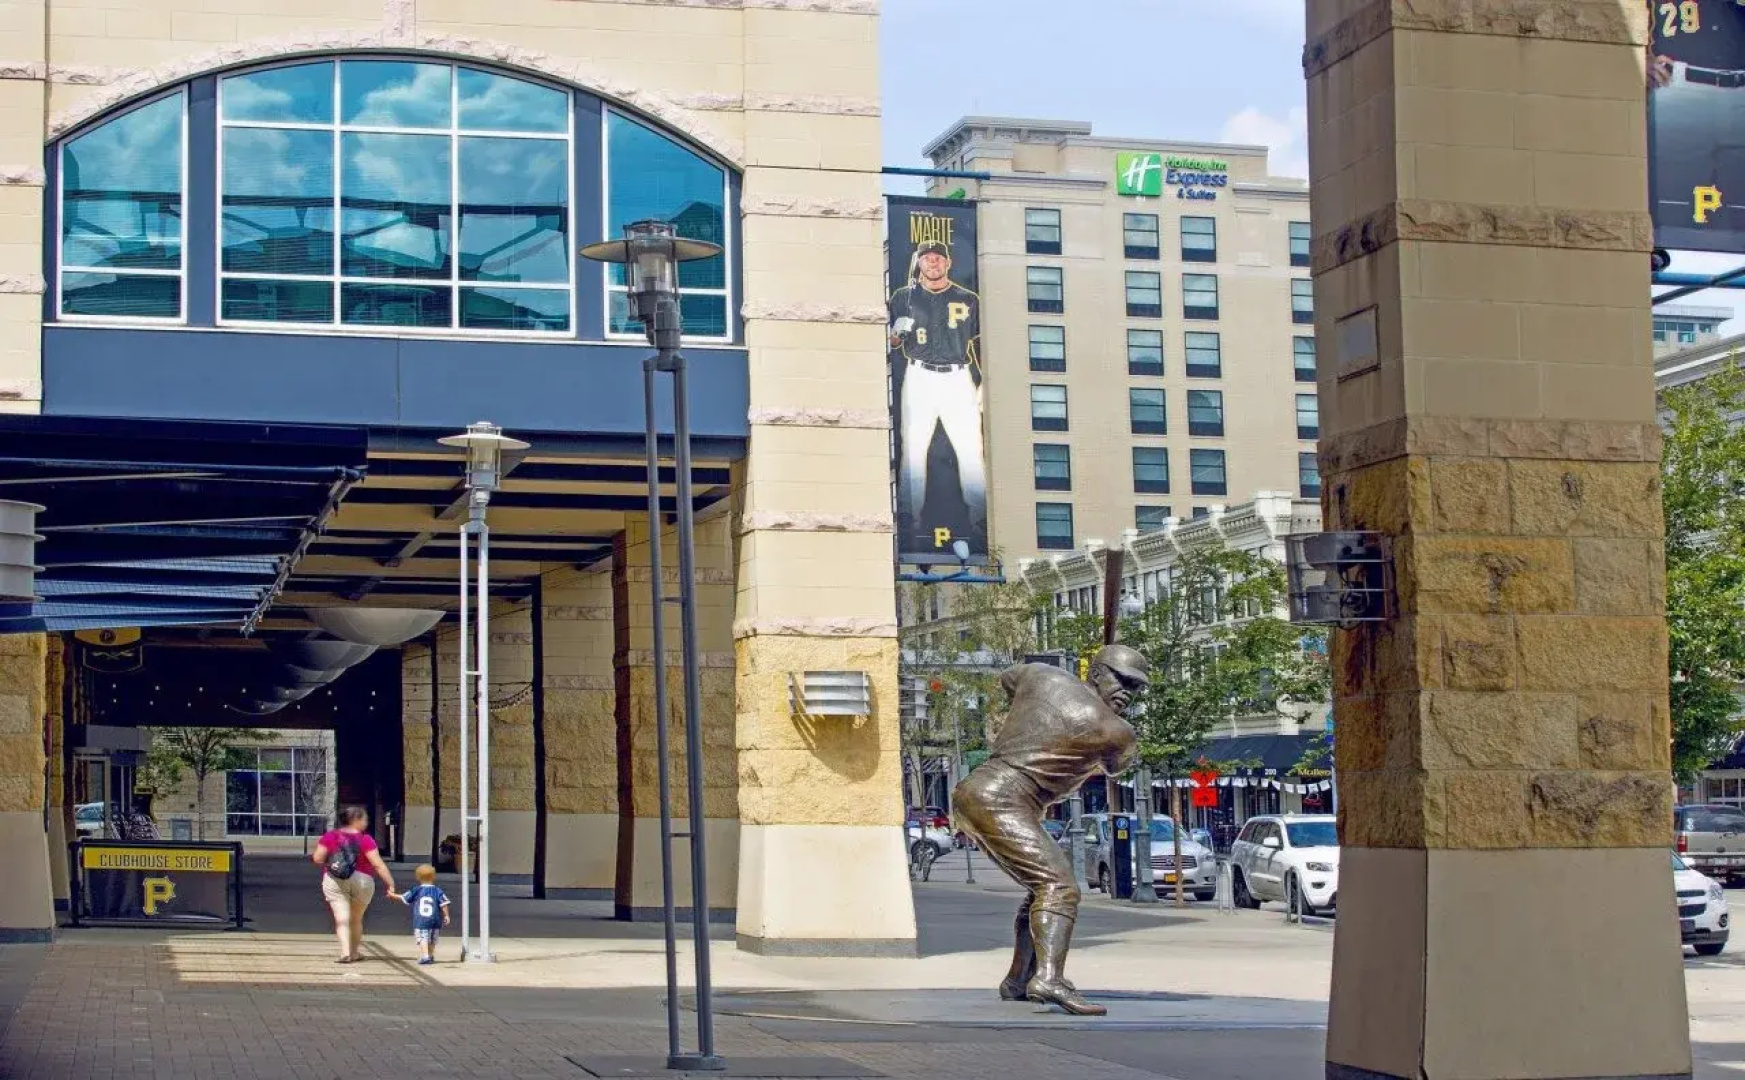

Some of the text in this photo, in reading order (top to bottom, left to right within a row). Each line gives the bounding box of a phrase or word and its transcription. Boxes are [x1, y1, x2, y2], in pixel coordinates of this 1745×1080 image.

[1659, 1, 1700, 37] 29
[1166, 156, 1227, 172] Holiday Inn
[1166, 168, 1227, 188] Express
[1177, 187, 1217, 200] & Suites
[1693, 185, 1723, 223] P
[910, 216, 954, 245] MARTE
[947, 302, 970, 329] P
[916, 327, 927, 344] 6
[934, 527, 951, 548] P
[100, 854, 213, 869] CLUBHOUSE STORE
[142, 876, 177, 915] P
[419, 896, 433, 917] 6
